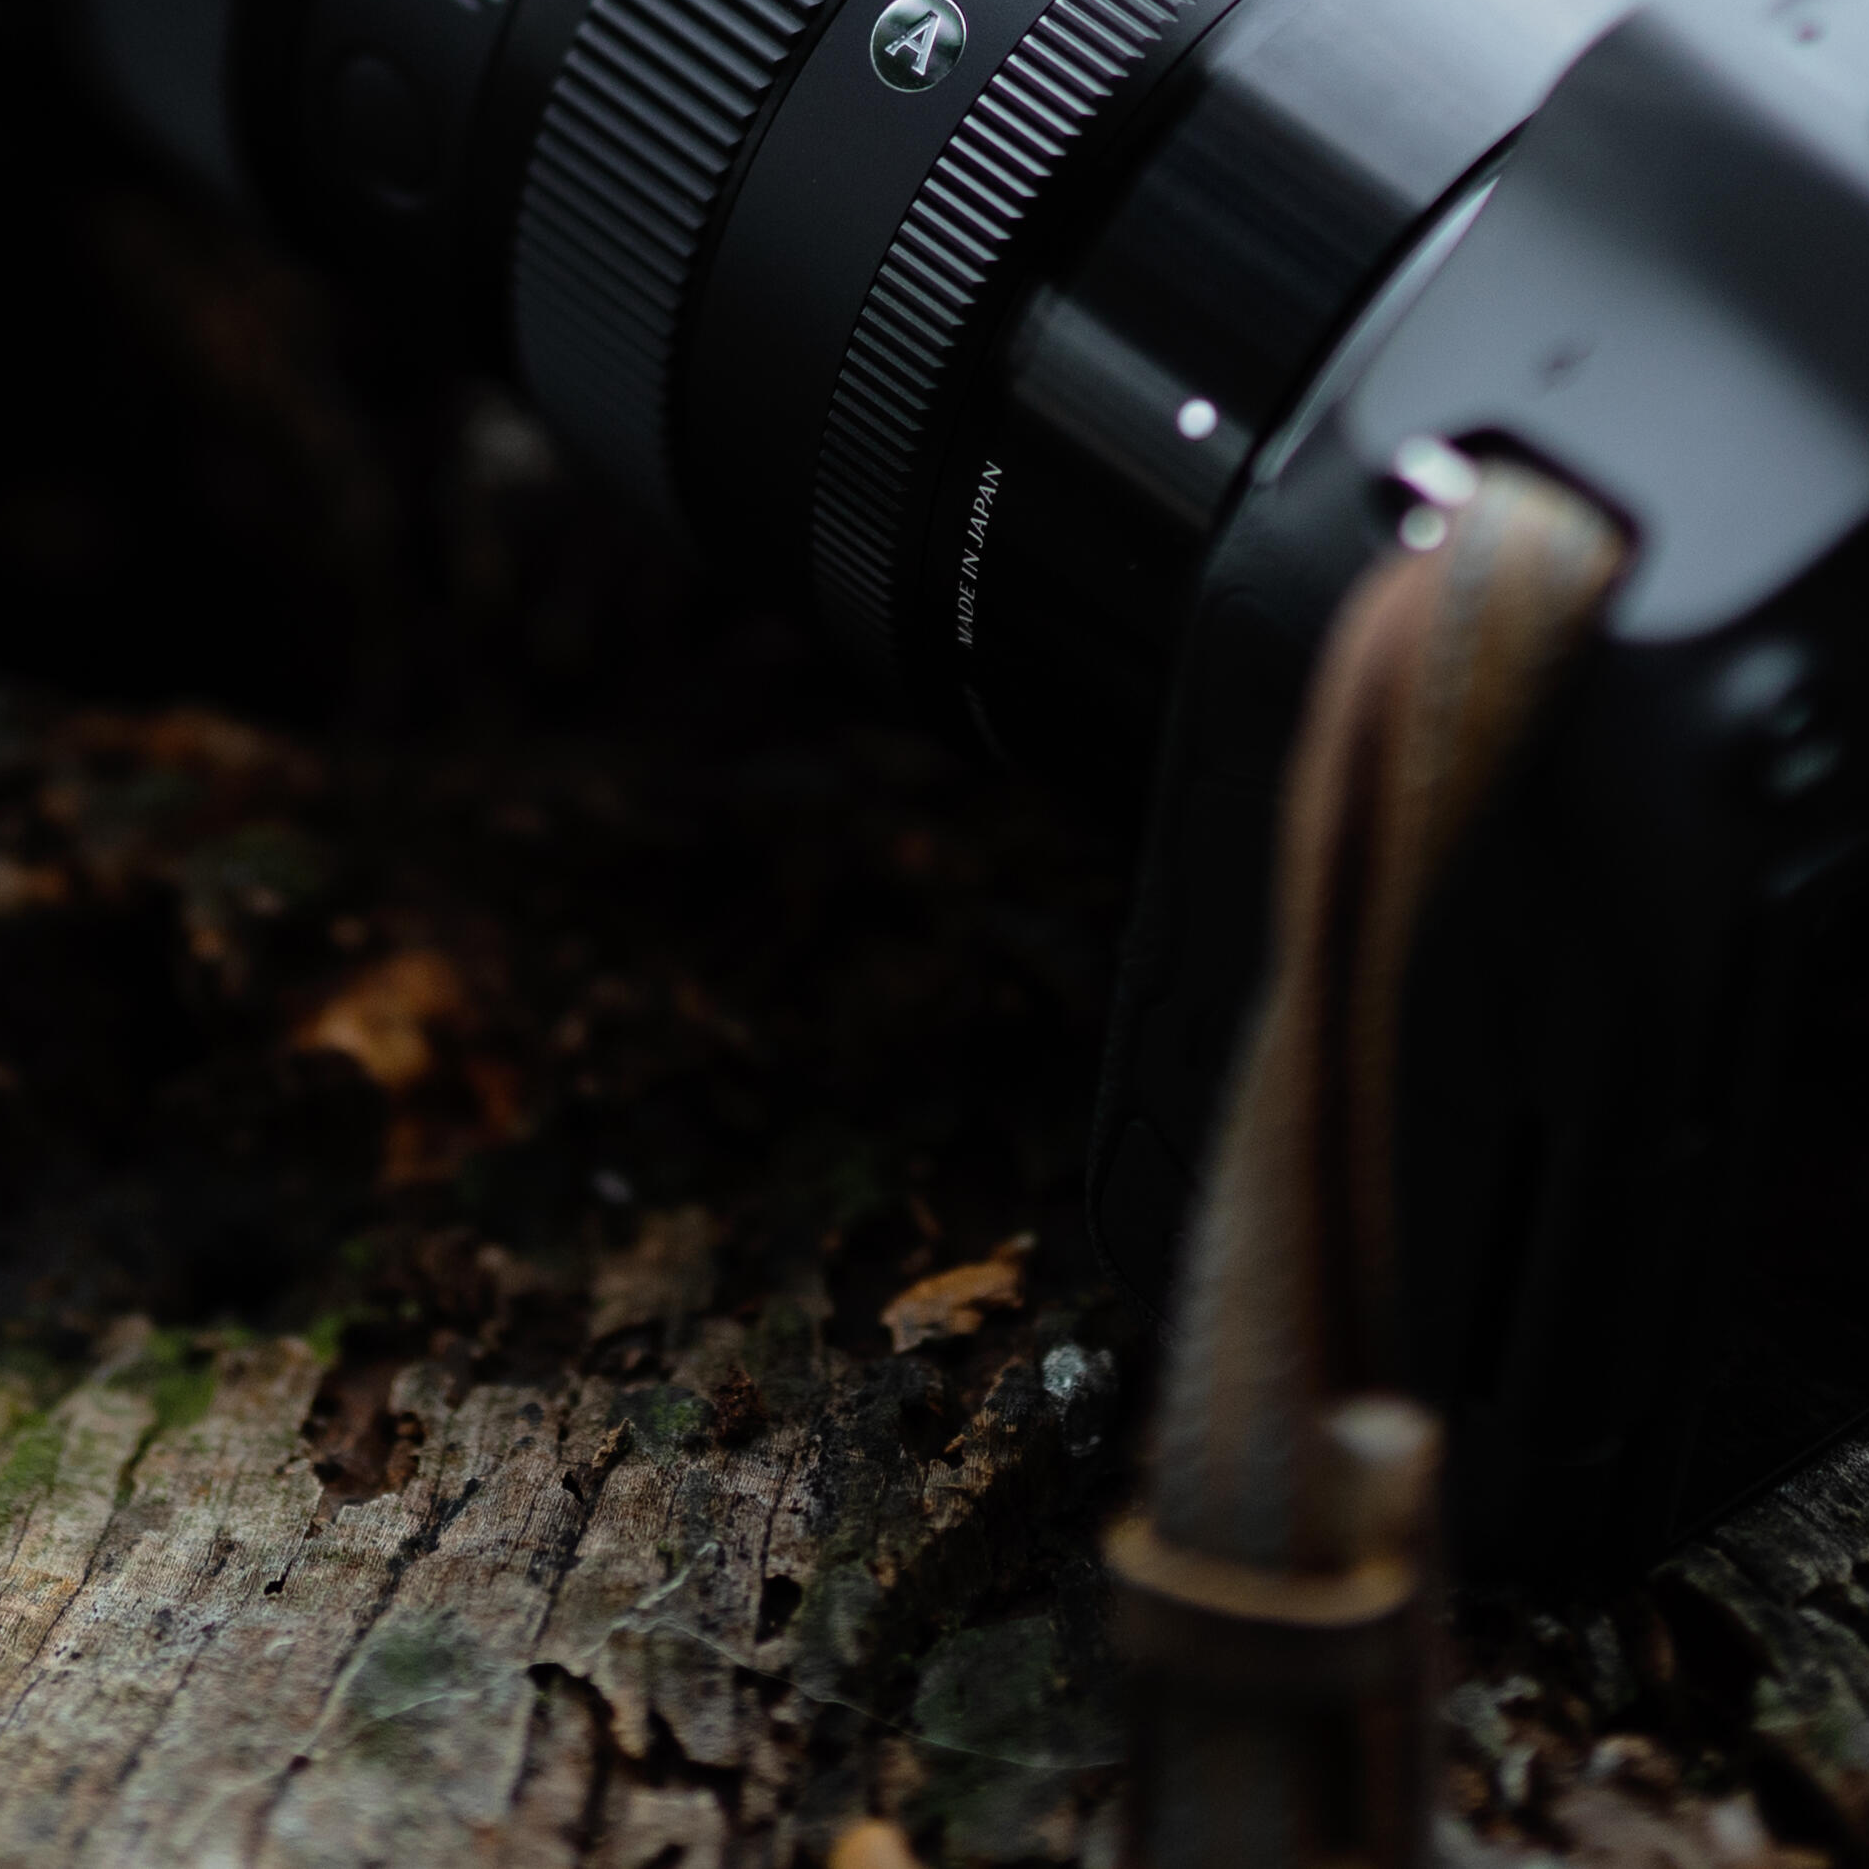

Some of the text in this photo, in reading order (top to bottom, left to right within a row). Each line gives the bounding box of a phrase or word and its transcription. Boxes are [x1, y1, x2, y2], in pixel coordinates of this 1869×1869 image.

[884, 10, 941, 76] A
[956, 460, 1004, 650] MADE IN JAPAN
